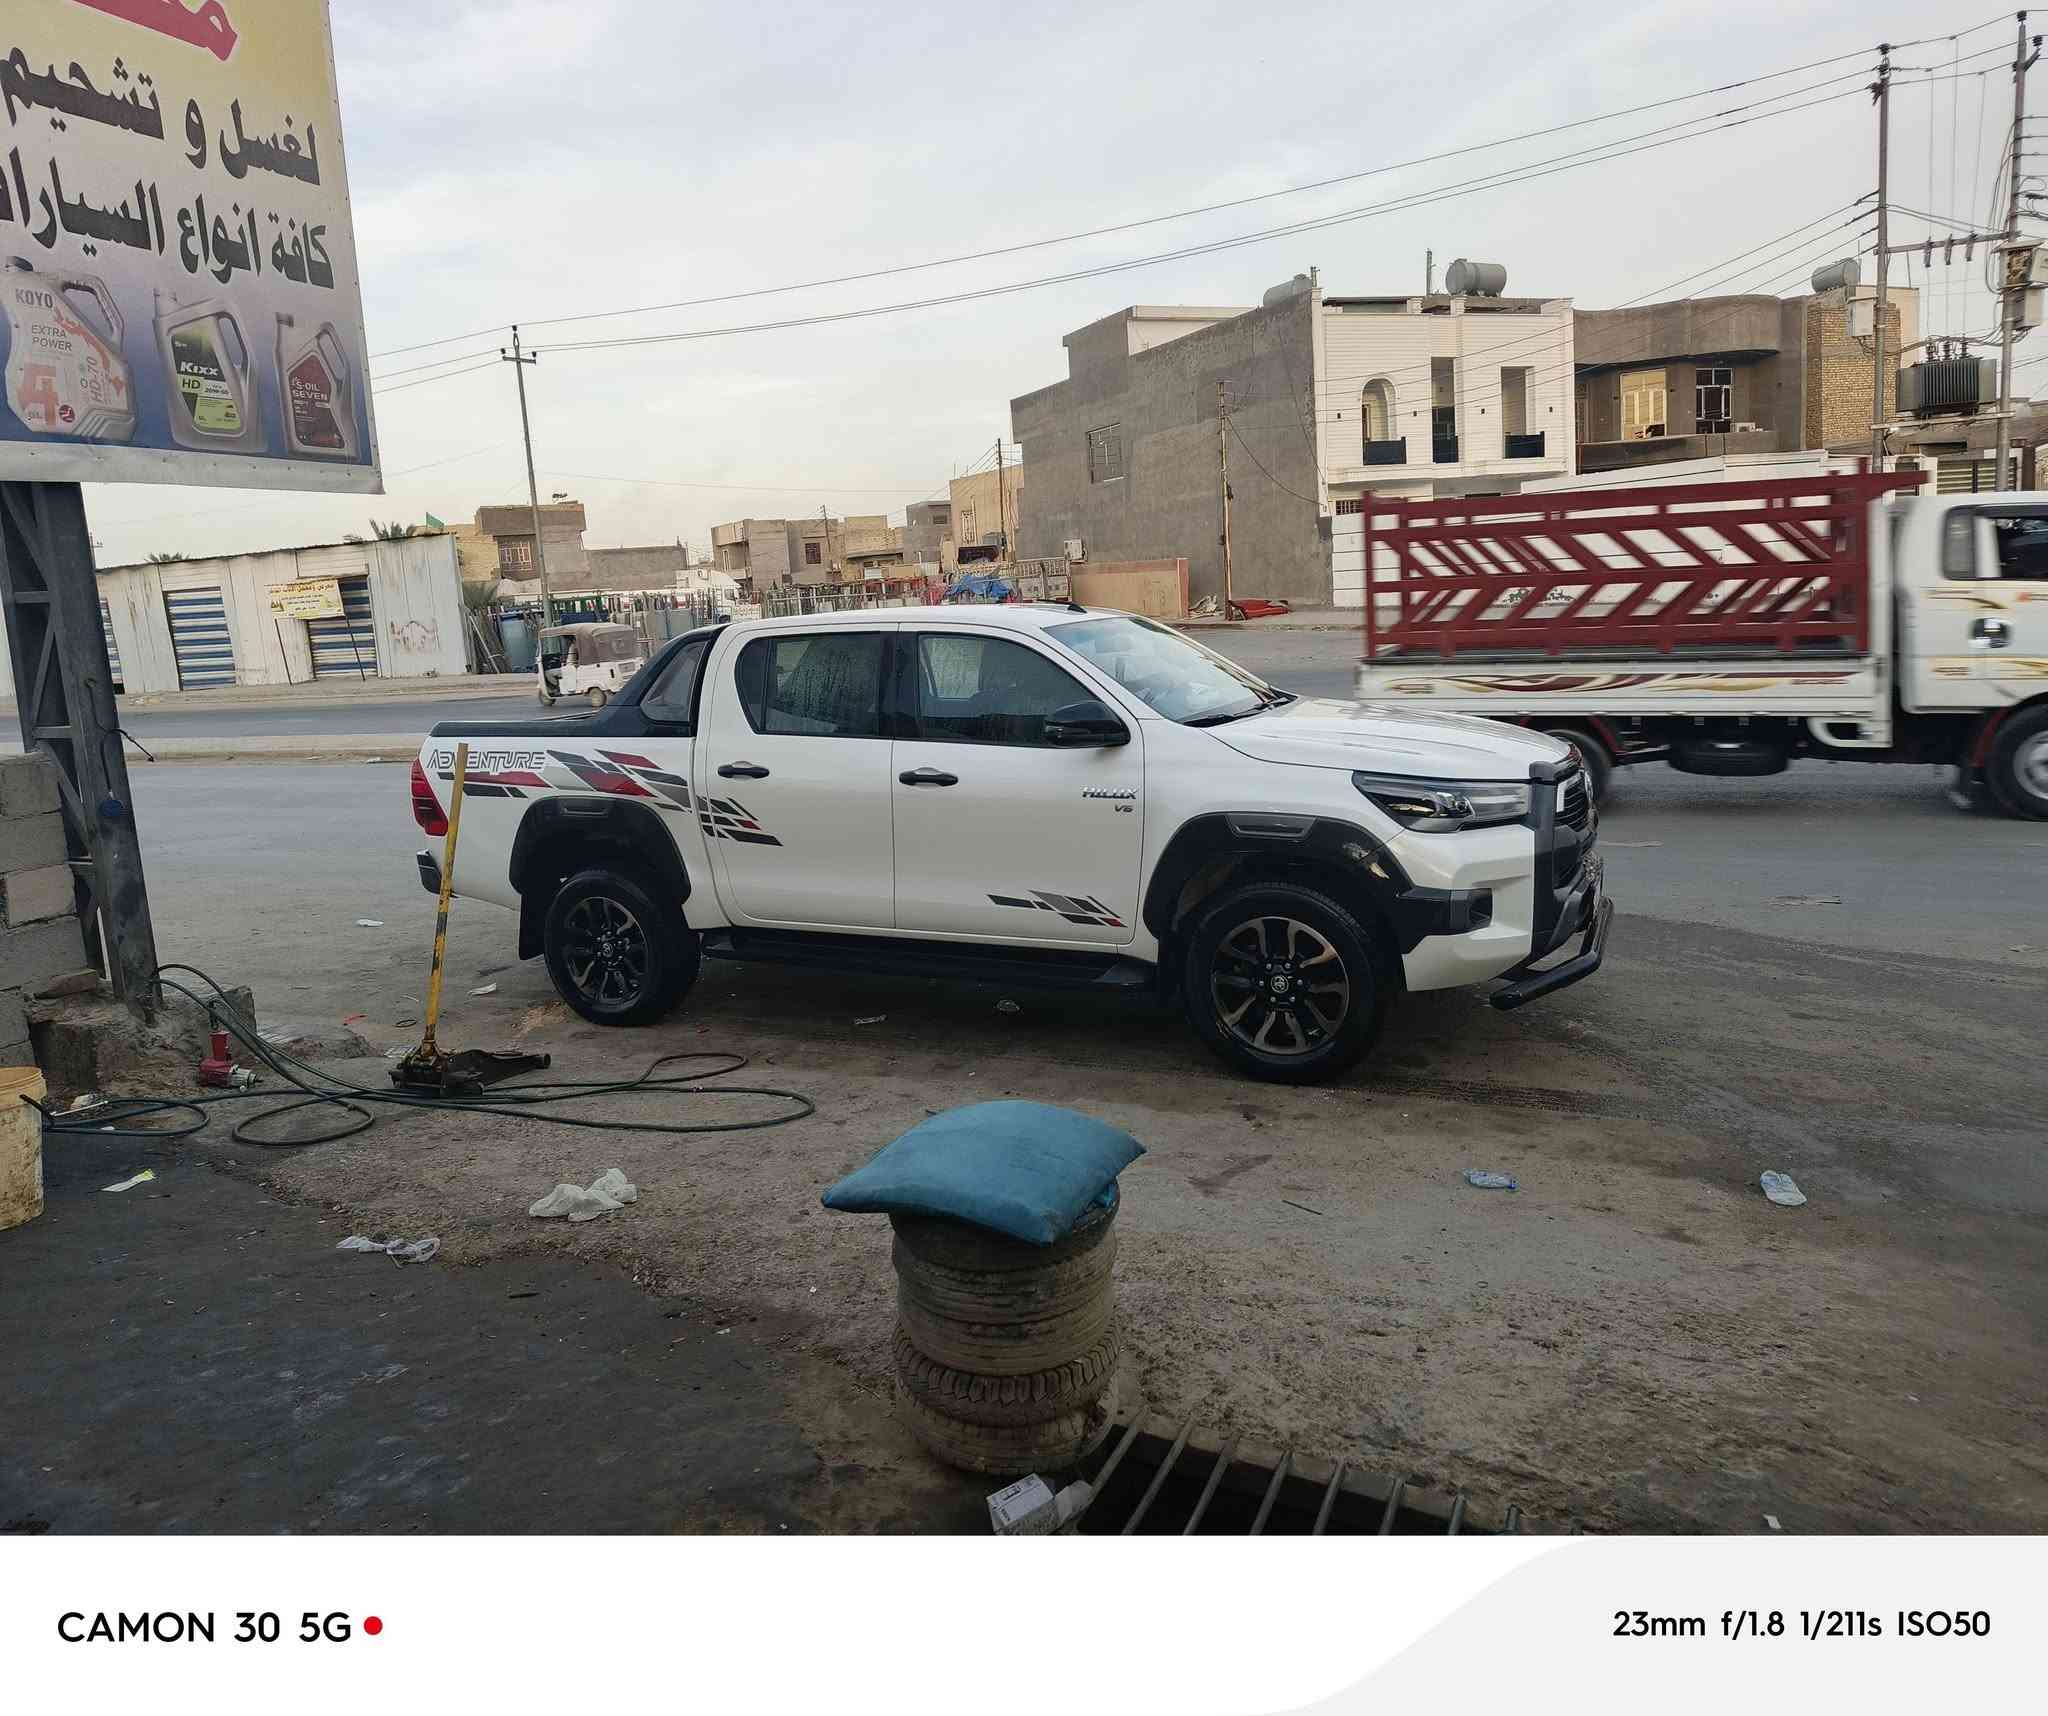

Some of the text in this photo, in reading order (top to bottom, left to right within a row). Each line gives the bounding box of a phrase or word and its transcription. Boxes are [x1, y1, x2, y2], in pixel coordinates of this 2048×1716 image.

[185, 98, 206, 169] و
[220, 98, 320, 186] لغسل
[267, 211, 335, 289] كافة
[16, 289, 53, 308] KOYO
[32, 324, 67, 338] EXTRA
[32, 337, 72, 351] POWER
[182, 379, 200, 389] HD
[1081, 787, 1138, 799] HILUX
